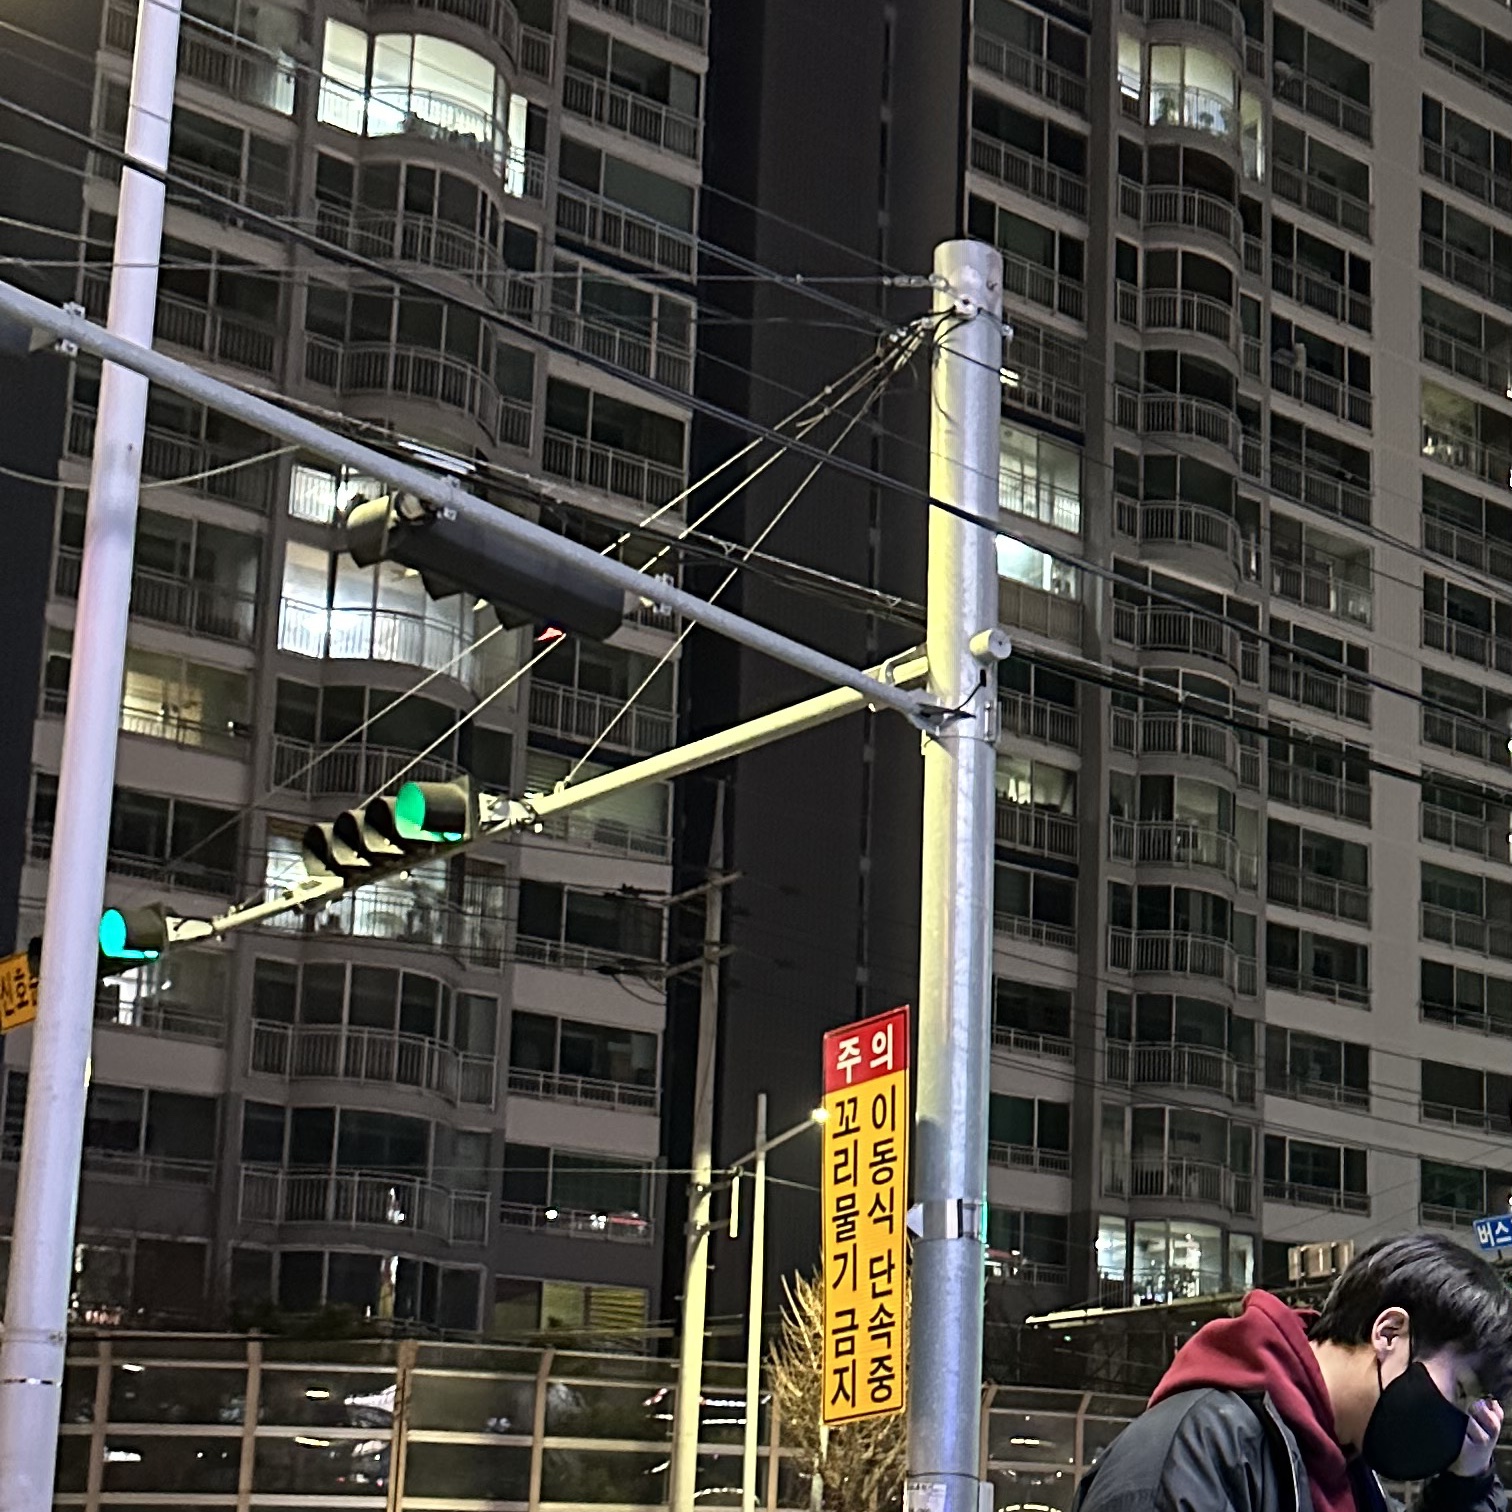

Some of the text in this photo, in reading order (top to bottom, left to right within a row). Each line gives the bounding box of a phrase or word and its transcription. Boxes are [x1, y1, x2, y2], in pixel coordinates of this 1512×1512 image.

[836, 1023, 893, 1084] 주의
[831, 1096, 861, 1408] 꼬리물기 금지
[867, 1084, 898, 1403] 이동식 단속중
